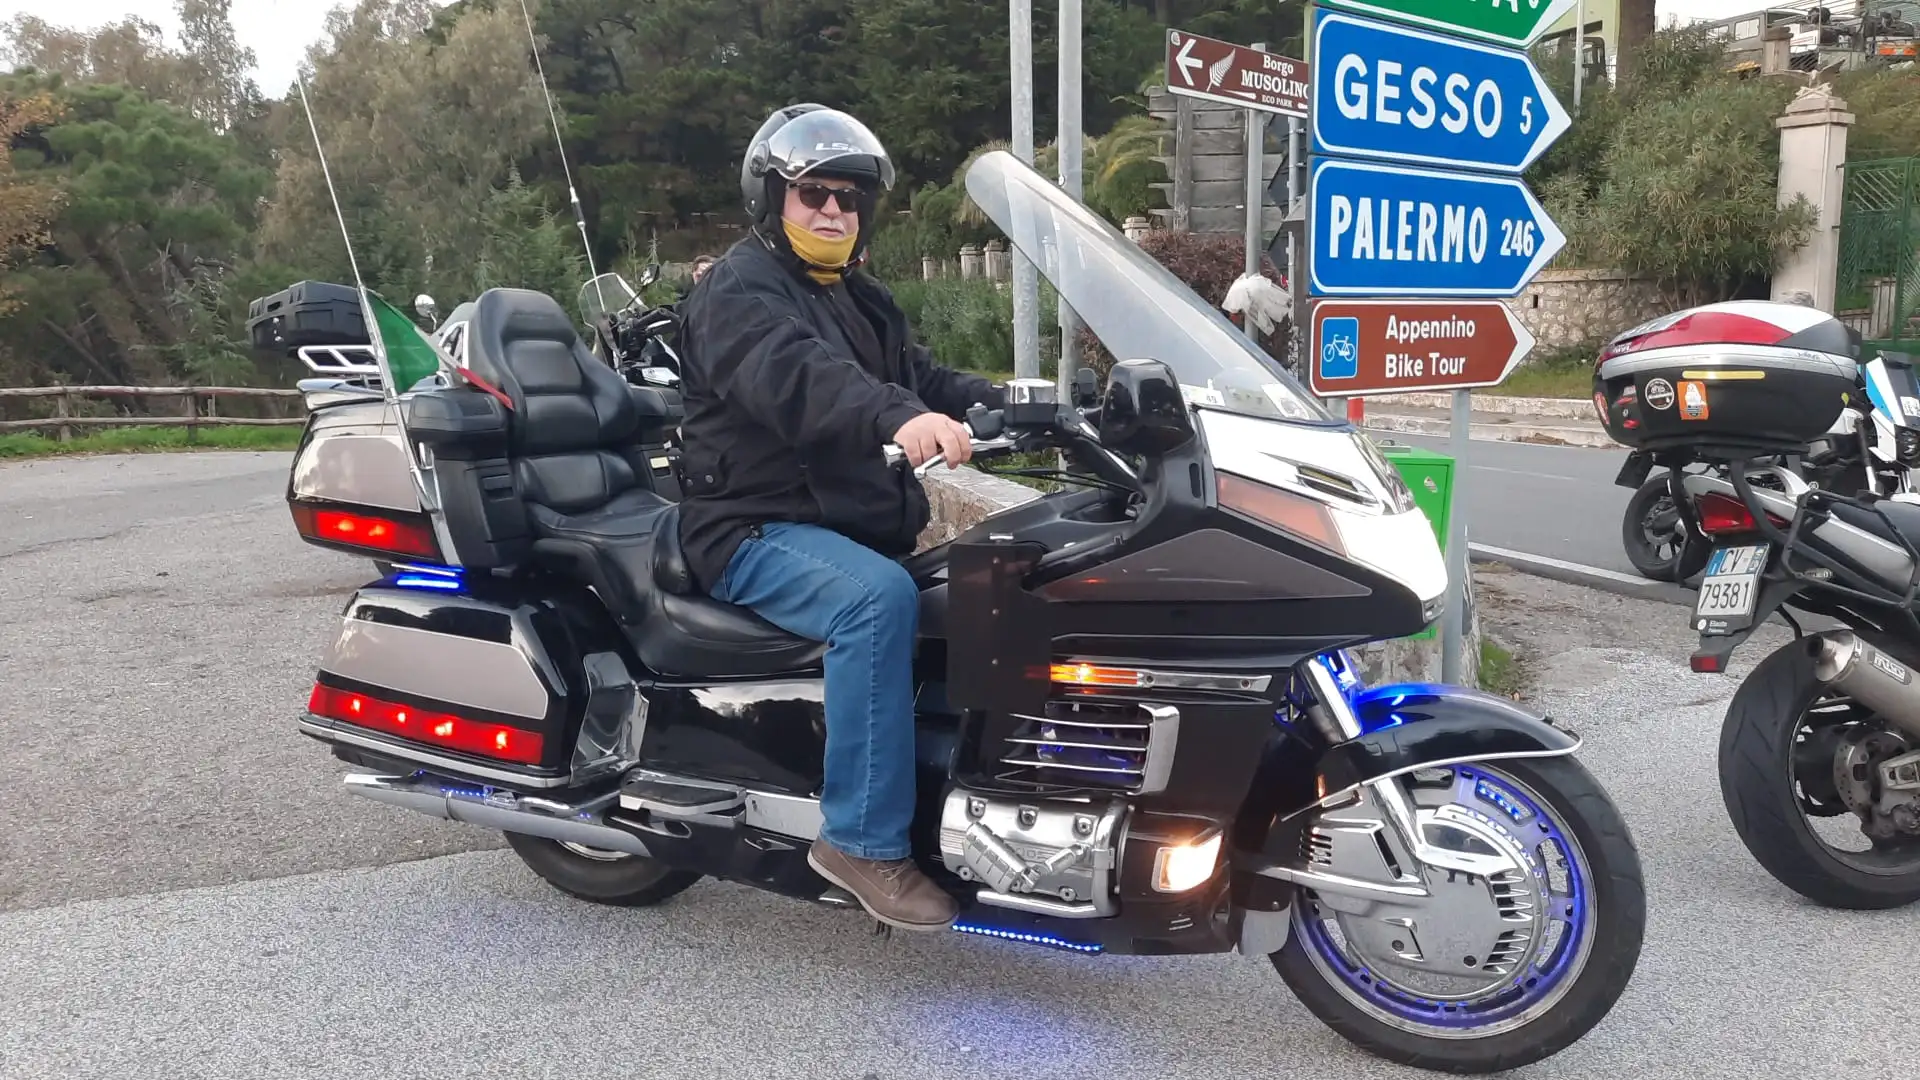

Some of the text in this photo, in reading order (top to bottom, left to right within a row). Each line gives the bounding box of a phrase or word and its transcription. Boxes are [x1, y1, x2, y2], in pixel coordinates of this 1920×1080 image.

[1263, 55, 1294, 77] Borgo
[1262, 94, 1275, 104] ECO
[1334, 53, 1533, 139] GESSO 5
[1329, 195, 1534, 264] PALERMO 246
[1385, 314, 1476, 344] Appennino
[1385, 352, 1466, 378] Bike Tour
[1720, 549, 1745, 573] CV
[1700, 582, 1749, 609] 79381
